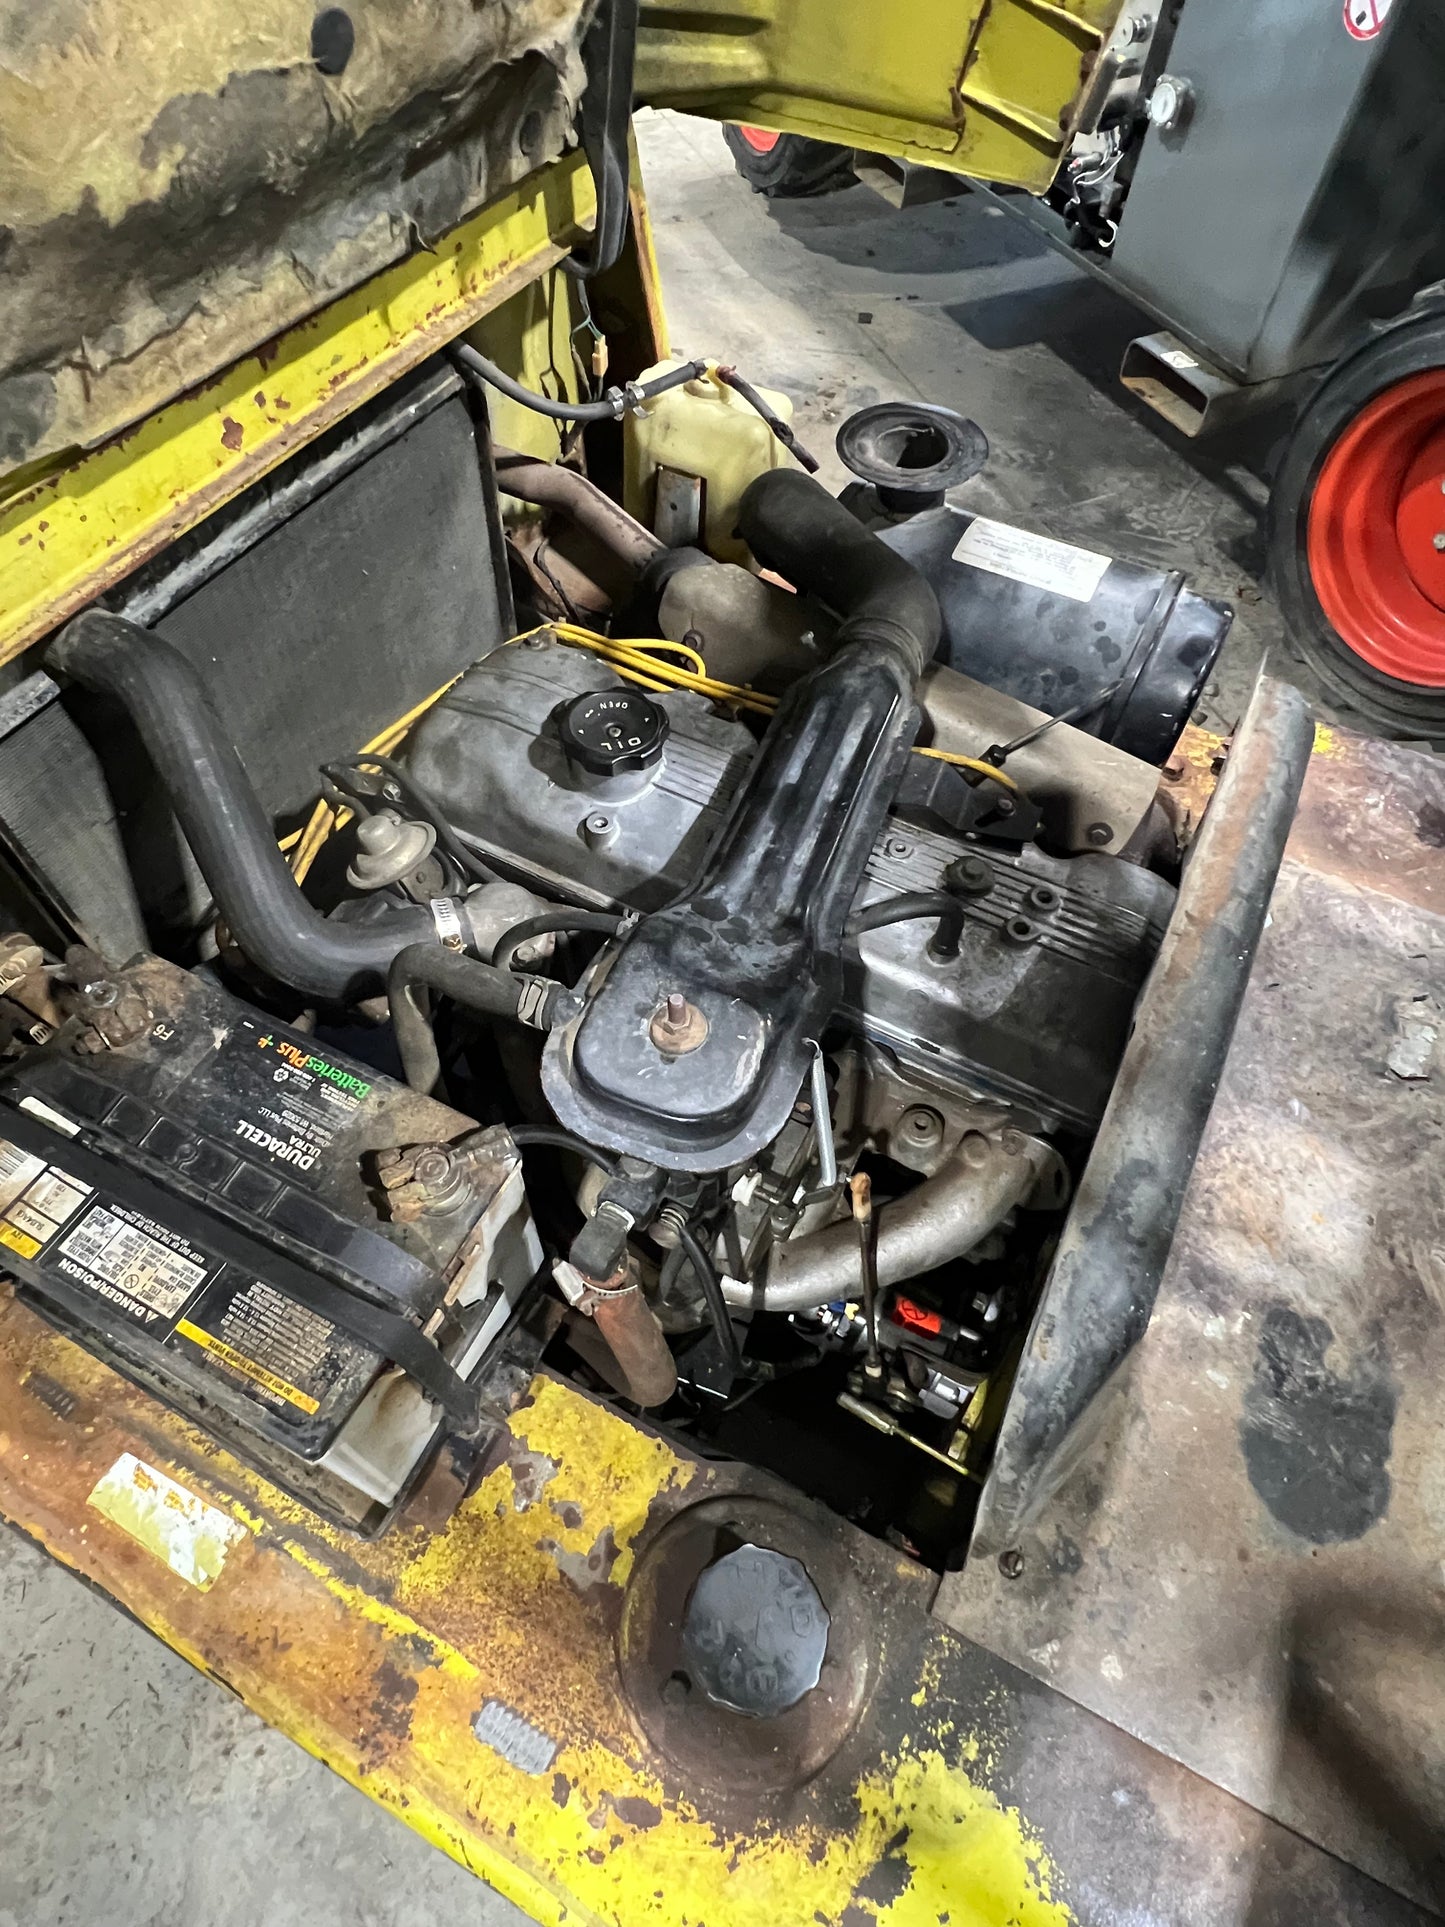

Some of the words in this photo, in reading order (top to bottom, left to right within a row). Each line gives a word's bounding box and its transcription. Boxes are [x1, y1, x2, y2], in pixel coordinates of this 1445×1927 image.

[599, 700, 627, 709] OPEN
[600, 737, 641, 750] OIL
[151, 1023, 174, 1040] F6
[276, 1041, 371, 1098] BatteriesPlus
[257, 1106, 271, 1117] LLC
[233, 1118, 315, 1170] DURACELL
[289, 1134, 321, 1157] ULTRA
[160, 1234, 173, 1244] THE
[177, 1244, 192, 1256] OUT
[188, 1251, 205, 1263] KEEP
[57, 1257, 146, 1316] DANGER/POISON
